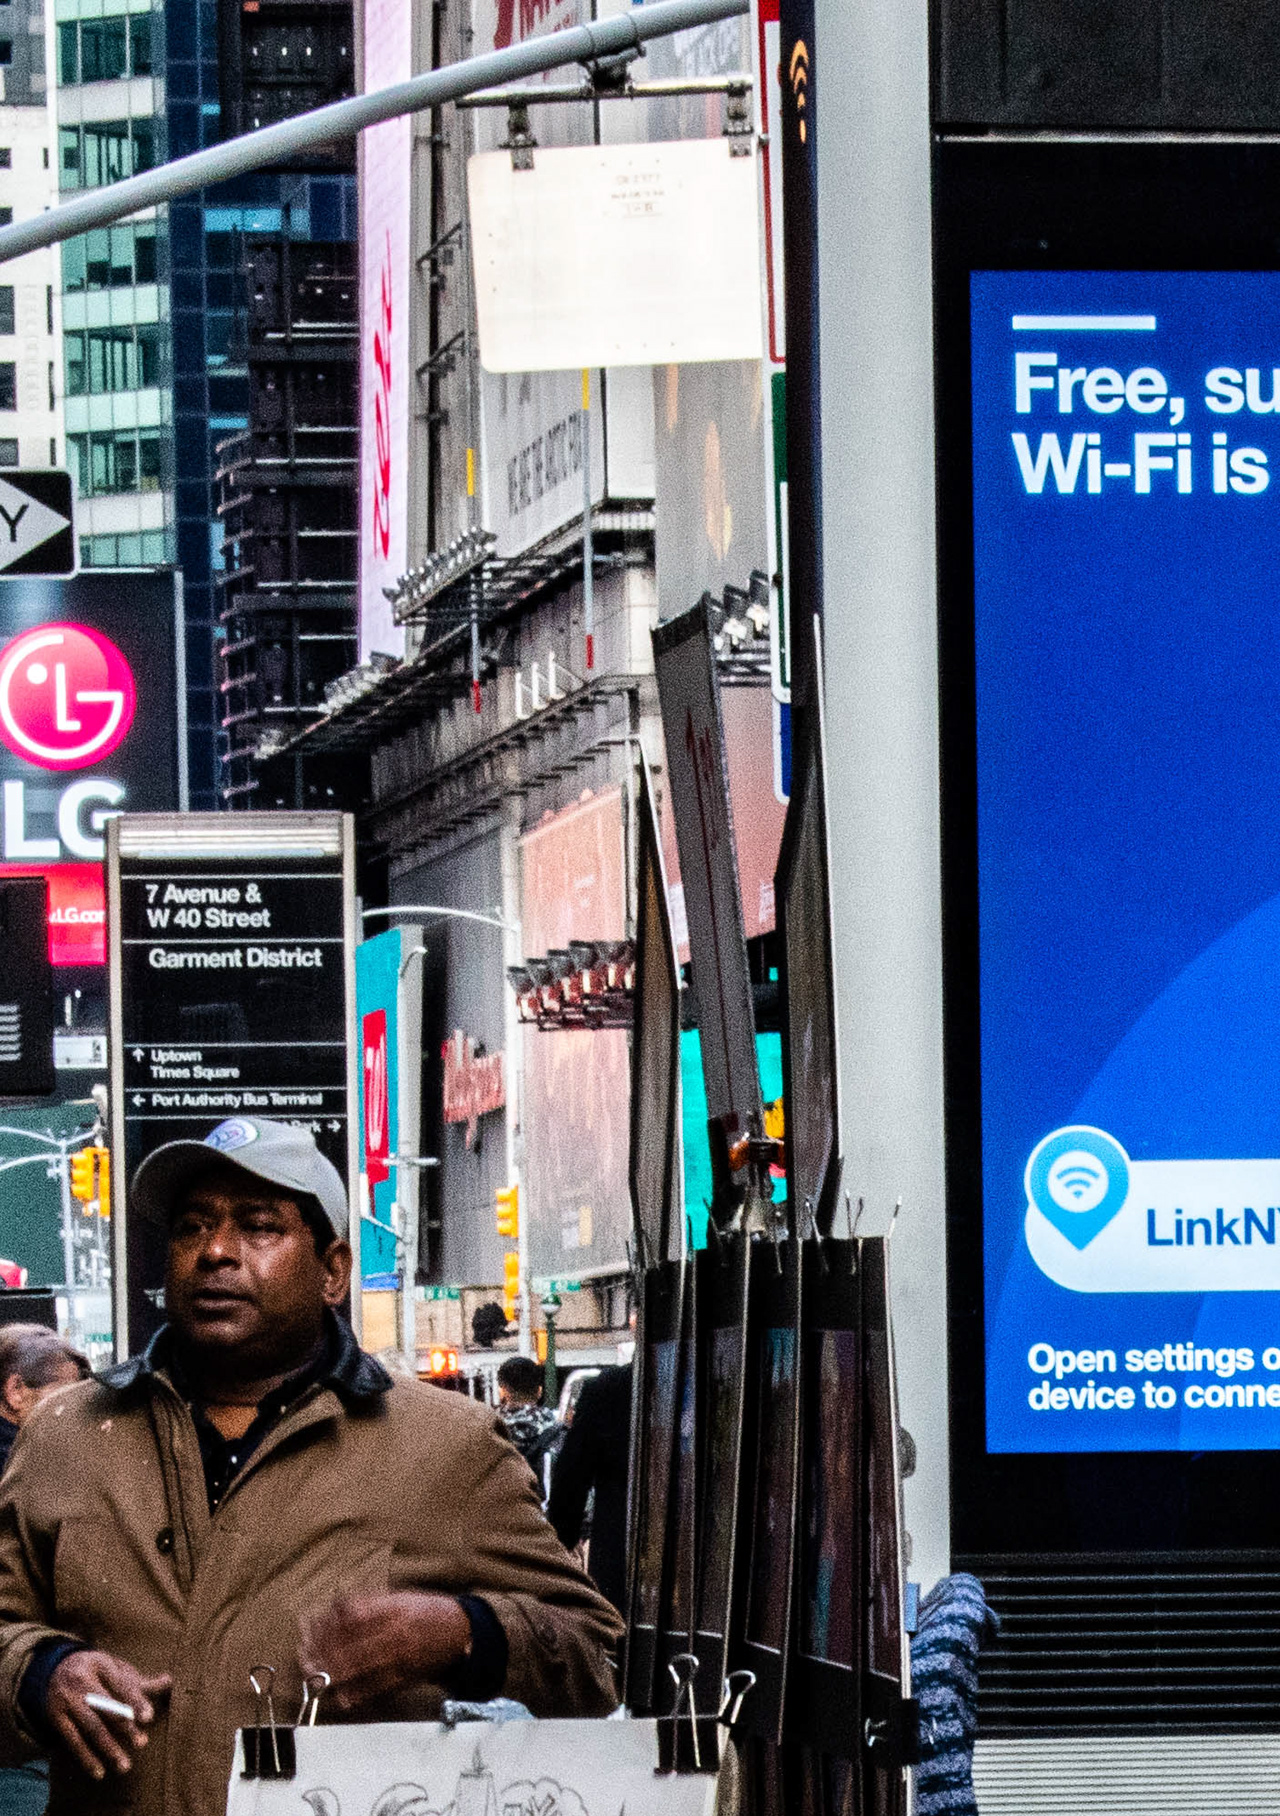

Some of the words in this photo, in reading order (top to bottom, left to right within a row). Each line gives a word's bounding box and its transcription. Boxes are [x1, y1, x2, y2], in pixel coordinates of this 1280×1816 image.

[1014, 352, 1186, 426] Free,
[1012, 432, 1192, 494] Wi-Fi
[1212, 432, 1268, 494] is
[4, 779, 125, 860] LG
[145, 884, 159, 904] 7
[162, 884, 240, 904] Avenue
[244, 883, 262, 904] &
[147, 909, 170, 928] W
[173, 908, 201, 928] 40
[204, 908, 271, 928] Street
[148, 948, 243, 969] Garment
[246, 947, 323, 968] District
[150, 1050, 202, 1064] Uptown
[150, 1065, 191, 1079] Times
[192, 1065, 240, 1081] Square
[151, 1092, 180, 1106] Port
[182, 1092, 242, 1108] Authority
[242, 1092, 269, 1106] Bus
[270, 1091, 323, 1105] Terminal
[1027, 1343, 1117, 1377] Open
[1125, 1343, 1255, 1377] settings
[1027, 1380, 1135, 1411] device
[1142, 1382, 1177, 1408] to
